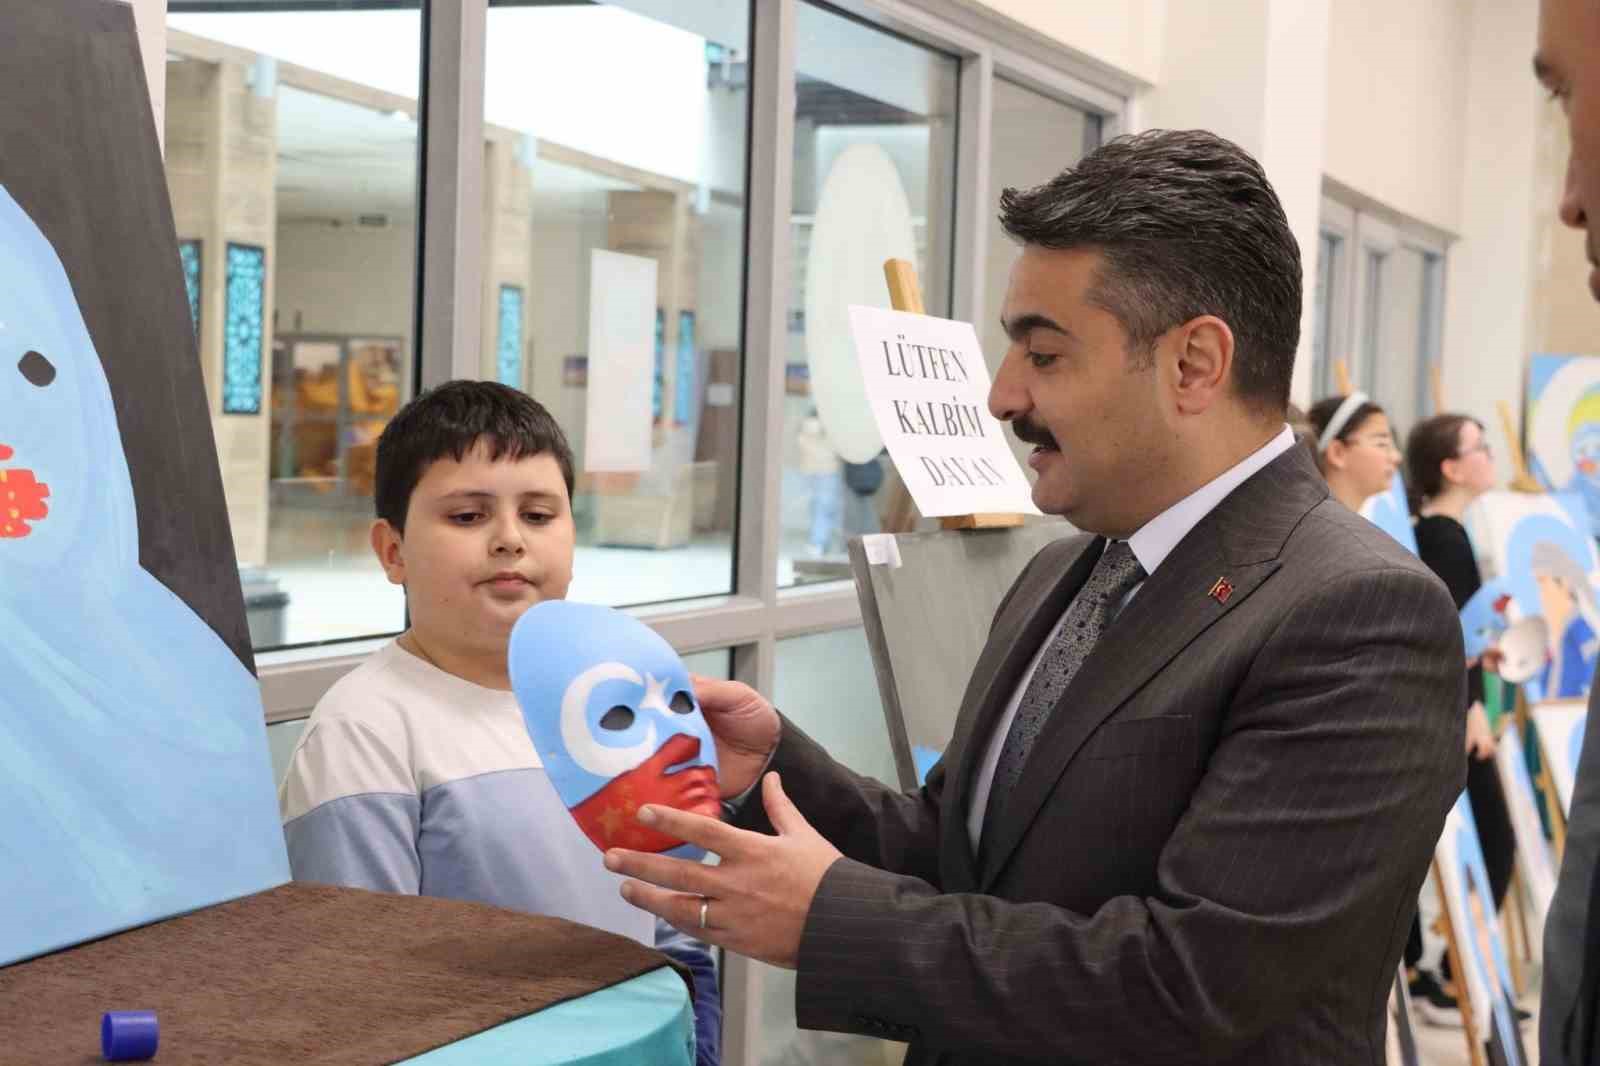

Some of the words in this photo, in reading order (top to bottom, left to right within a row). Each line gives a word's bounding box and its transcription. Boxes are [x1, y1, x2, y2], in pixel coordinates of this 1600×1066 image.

[881, 334, 969, 383] LÜTFEN
[893, 395, 986, 437] KALBİM
[920, 456, 1007, 486] DAYAN
